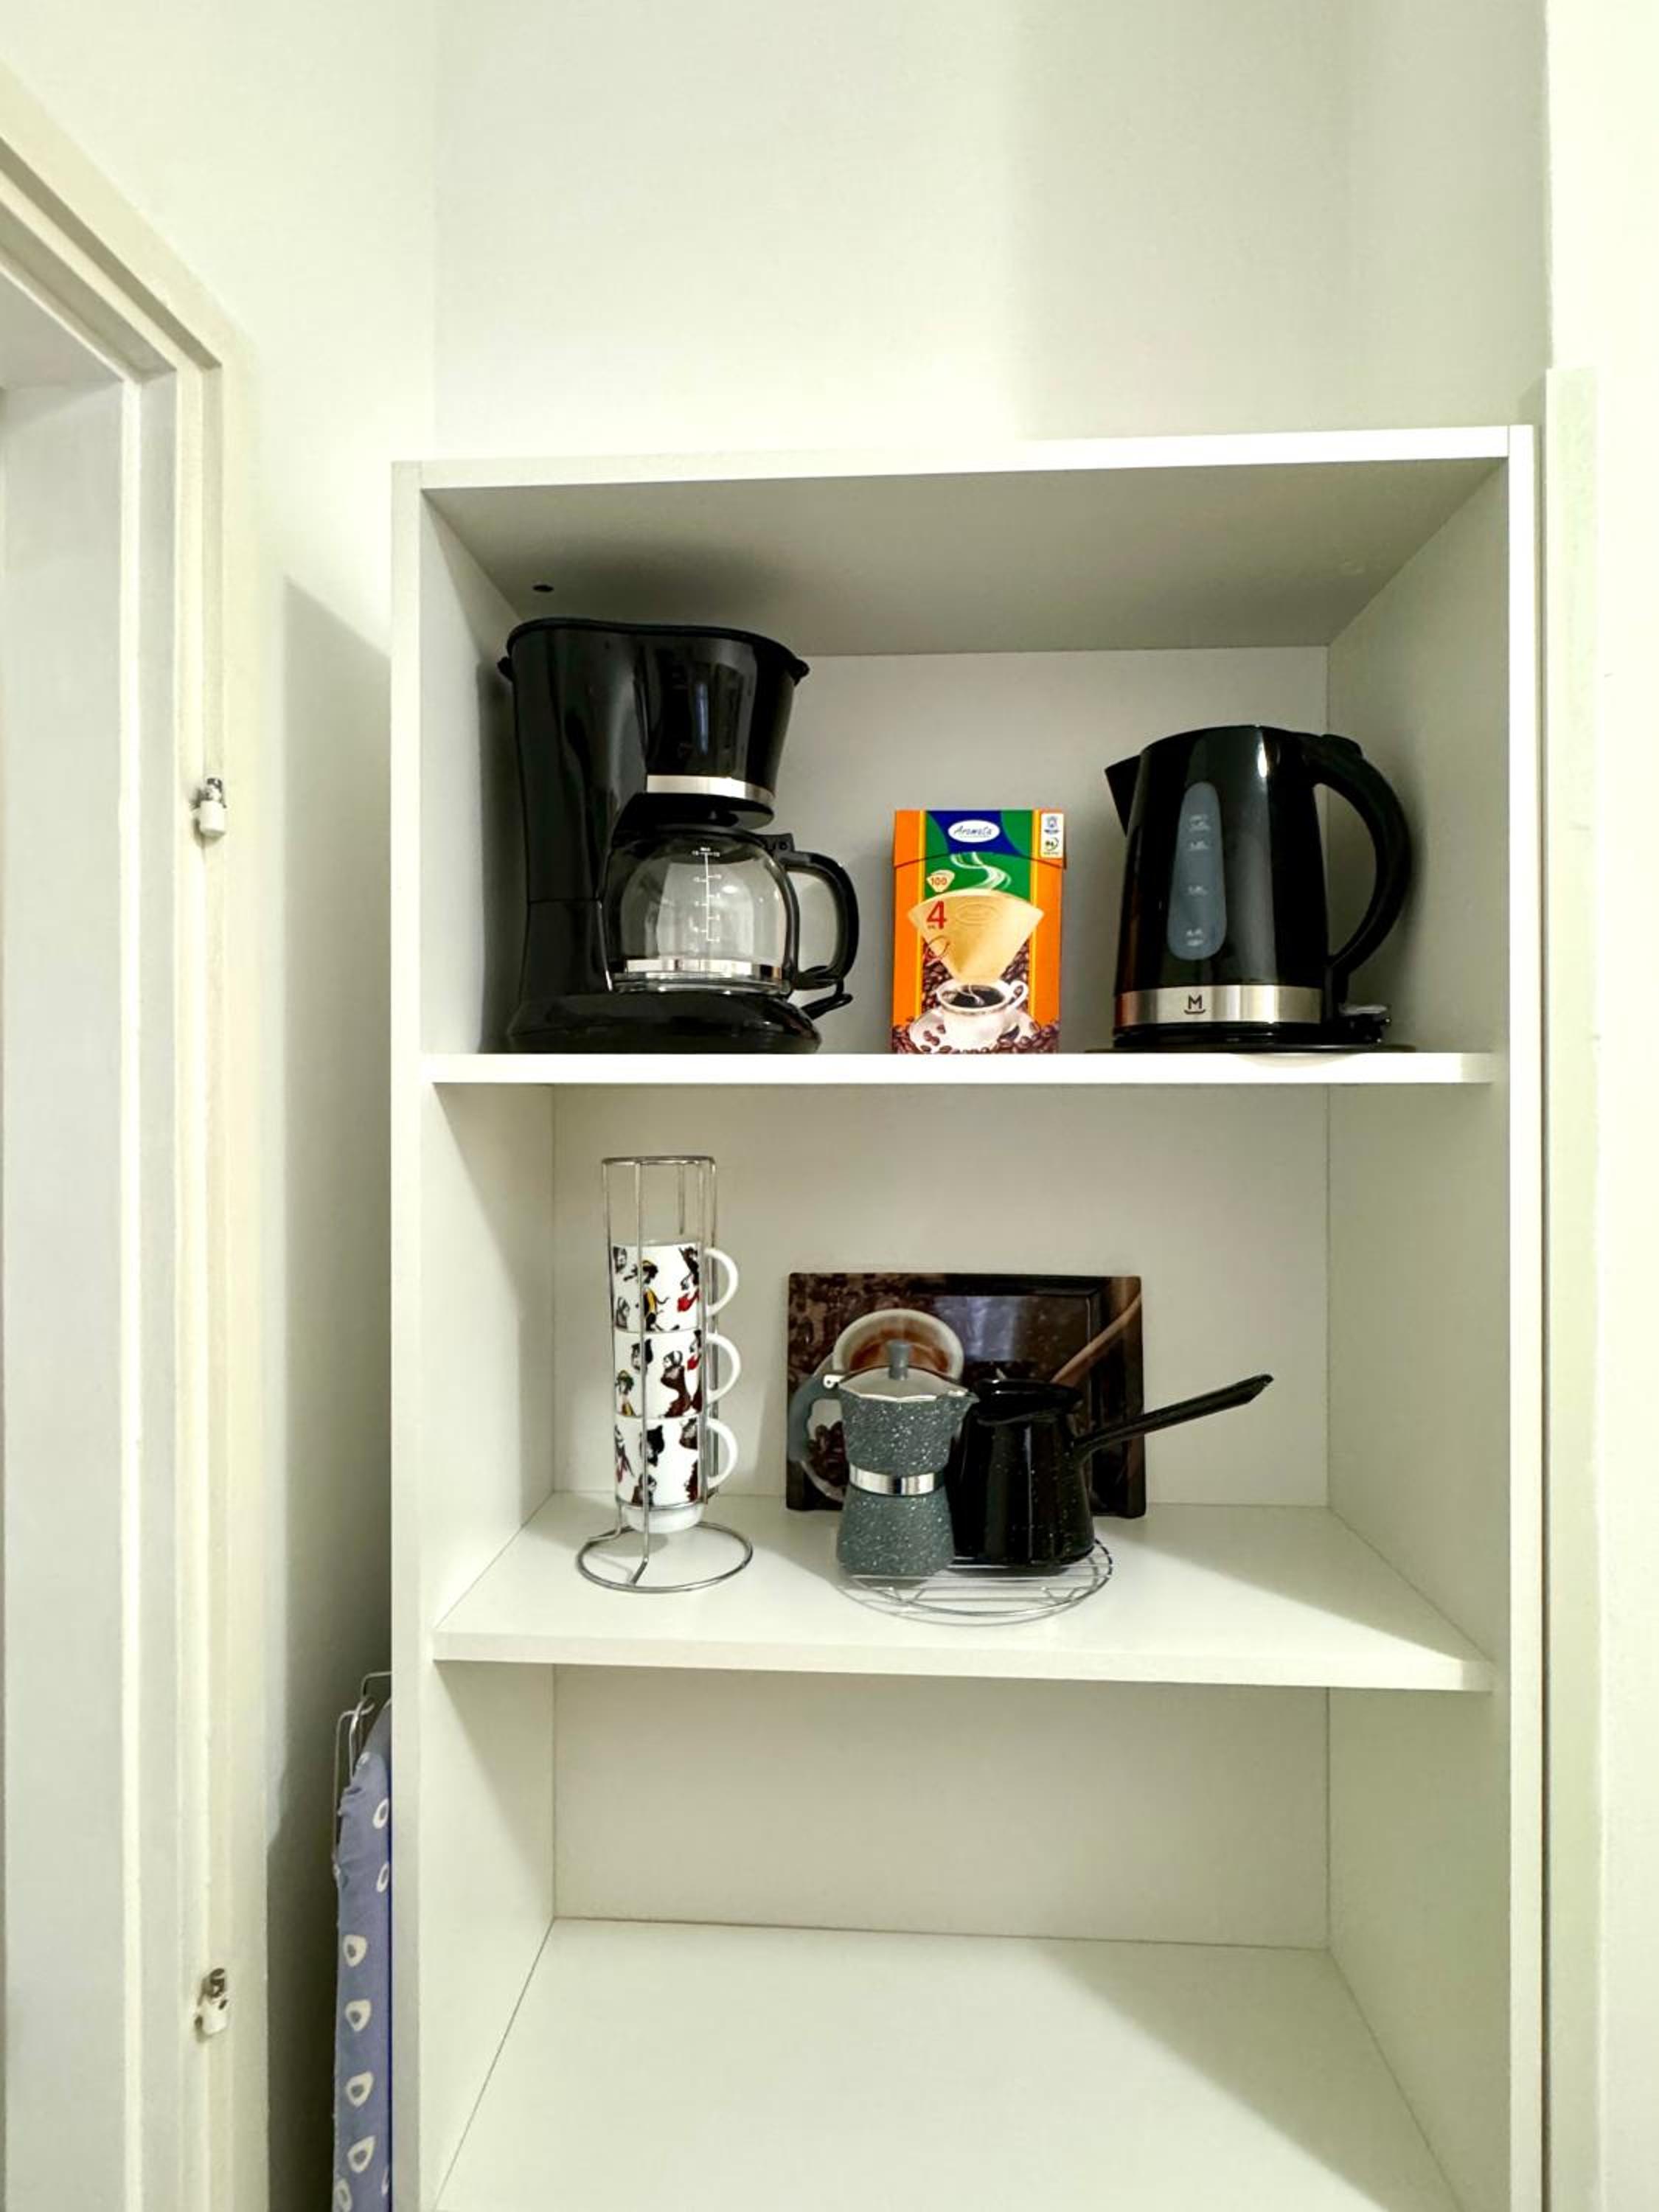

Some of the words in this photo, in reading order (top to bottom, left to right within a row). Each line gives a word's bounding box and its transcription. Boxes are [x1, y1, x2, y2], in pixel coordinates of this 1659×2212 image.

[931, 877, 947, 886] 100
[927, 900, 947, 930] 4
[1188, 995, 1203, 1009] M
